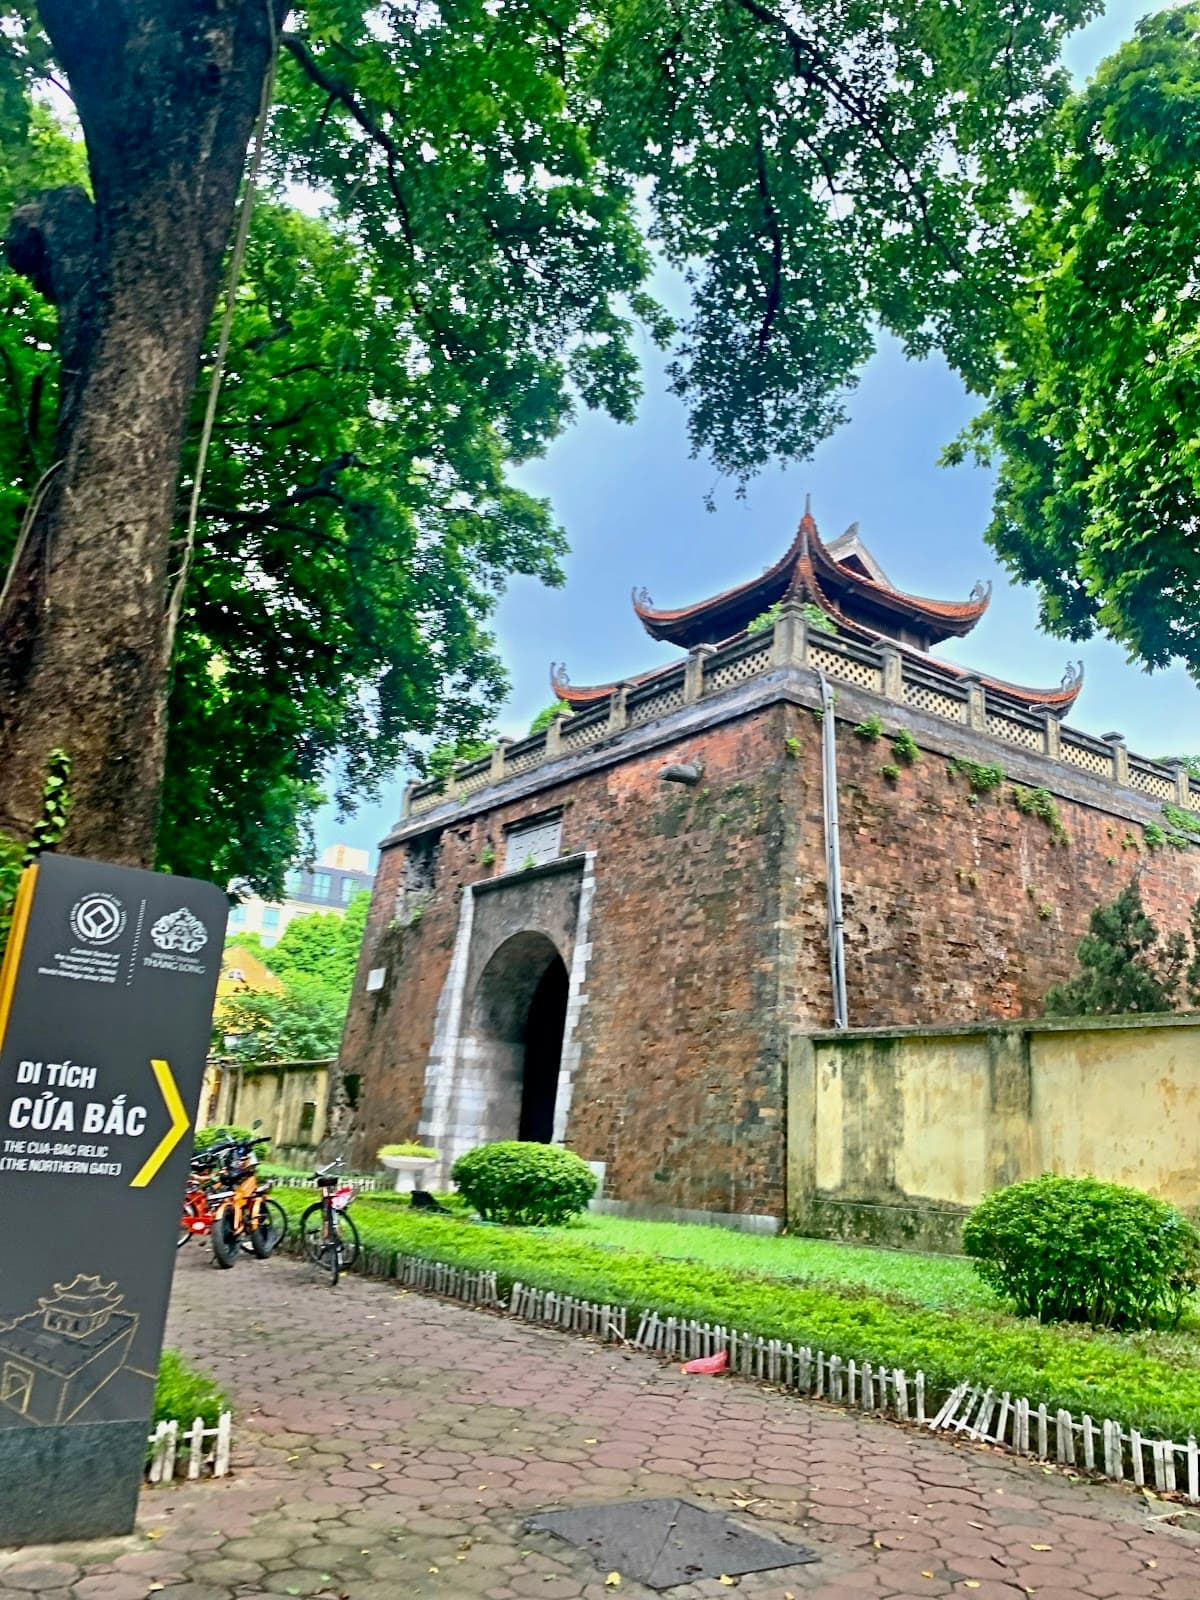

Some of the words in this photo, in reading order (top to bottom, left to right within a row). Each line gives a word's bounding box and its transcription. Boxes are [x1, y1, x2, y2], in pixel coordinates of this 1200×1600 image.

[16, 1061, 43, 1085] DI
[46, 1060, 98, 1089] TÍCH
[8, 1091, 75, 1132] CỬA
[82, 1093, 147, 1137] BẮC
[3, 1140, 27, 1153] THE
[27, 1141, 76, 1155] CUA-BAC
[77, 1144, 109, 1158] RELIC
[0, 1156, 28, 1171] (THE
[29, 1158, 89, 1174] NORTHERN
[89, 1162, 122, 1176] GATE)
